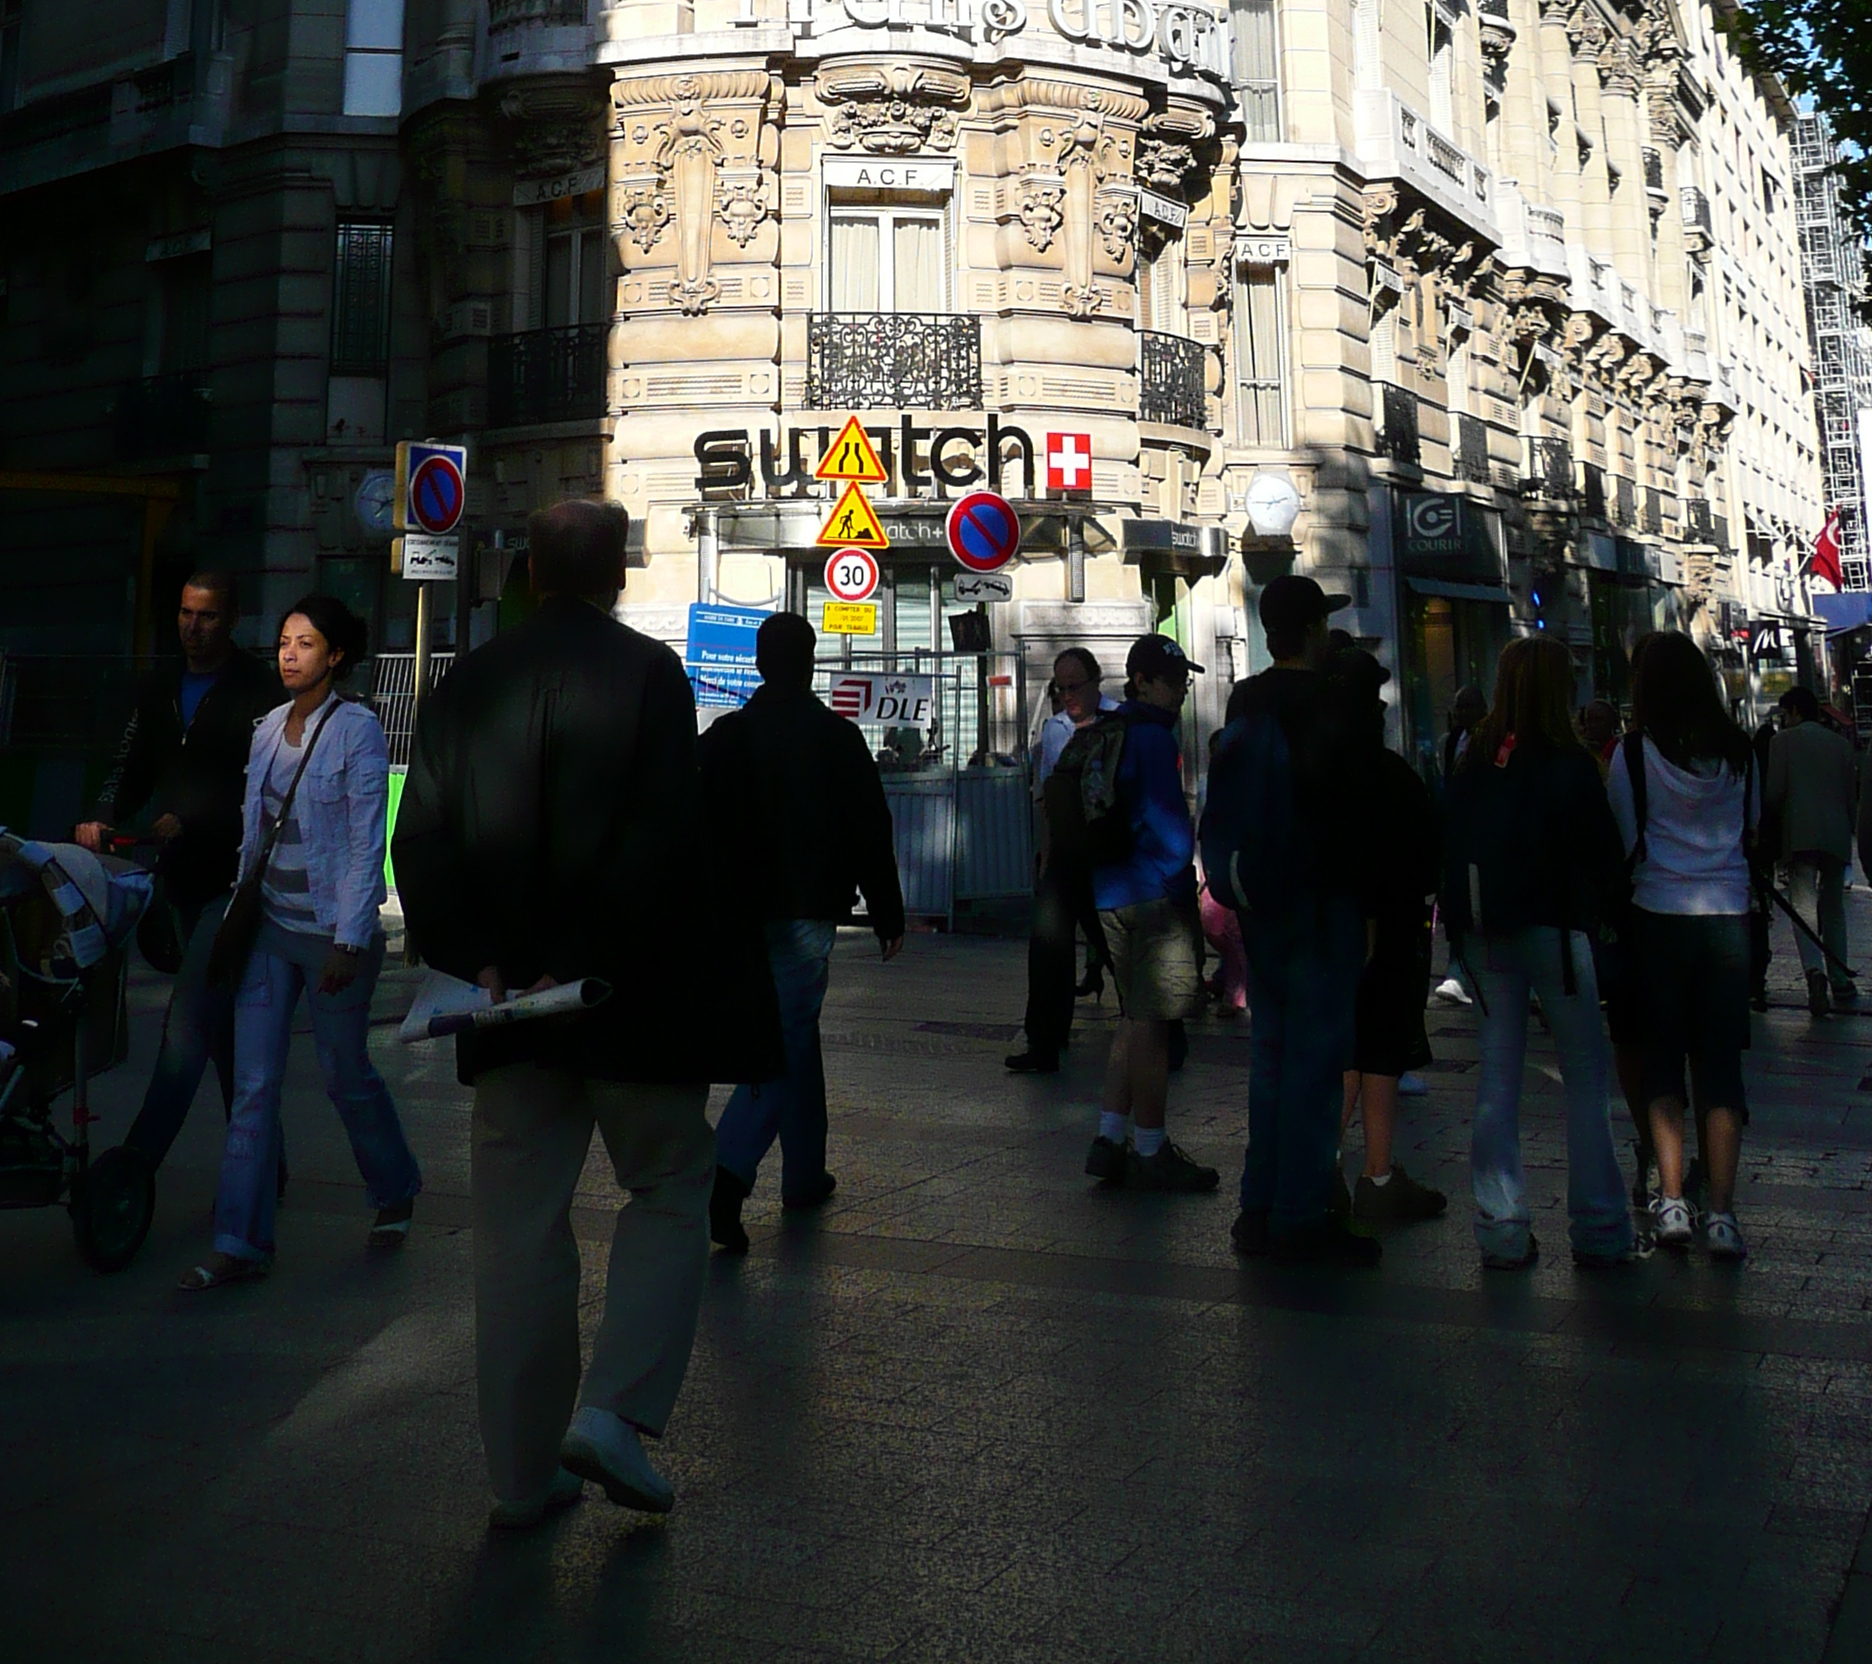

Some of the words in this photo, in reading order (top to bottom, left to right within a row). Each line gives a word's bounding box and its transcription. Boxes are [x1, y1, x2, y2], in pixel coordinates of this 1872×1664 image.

[1408, 538, 1462, 552] COURIR
[840, 565, 864, 586] 30
[876, 697, 929, 721] DLE
